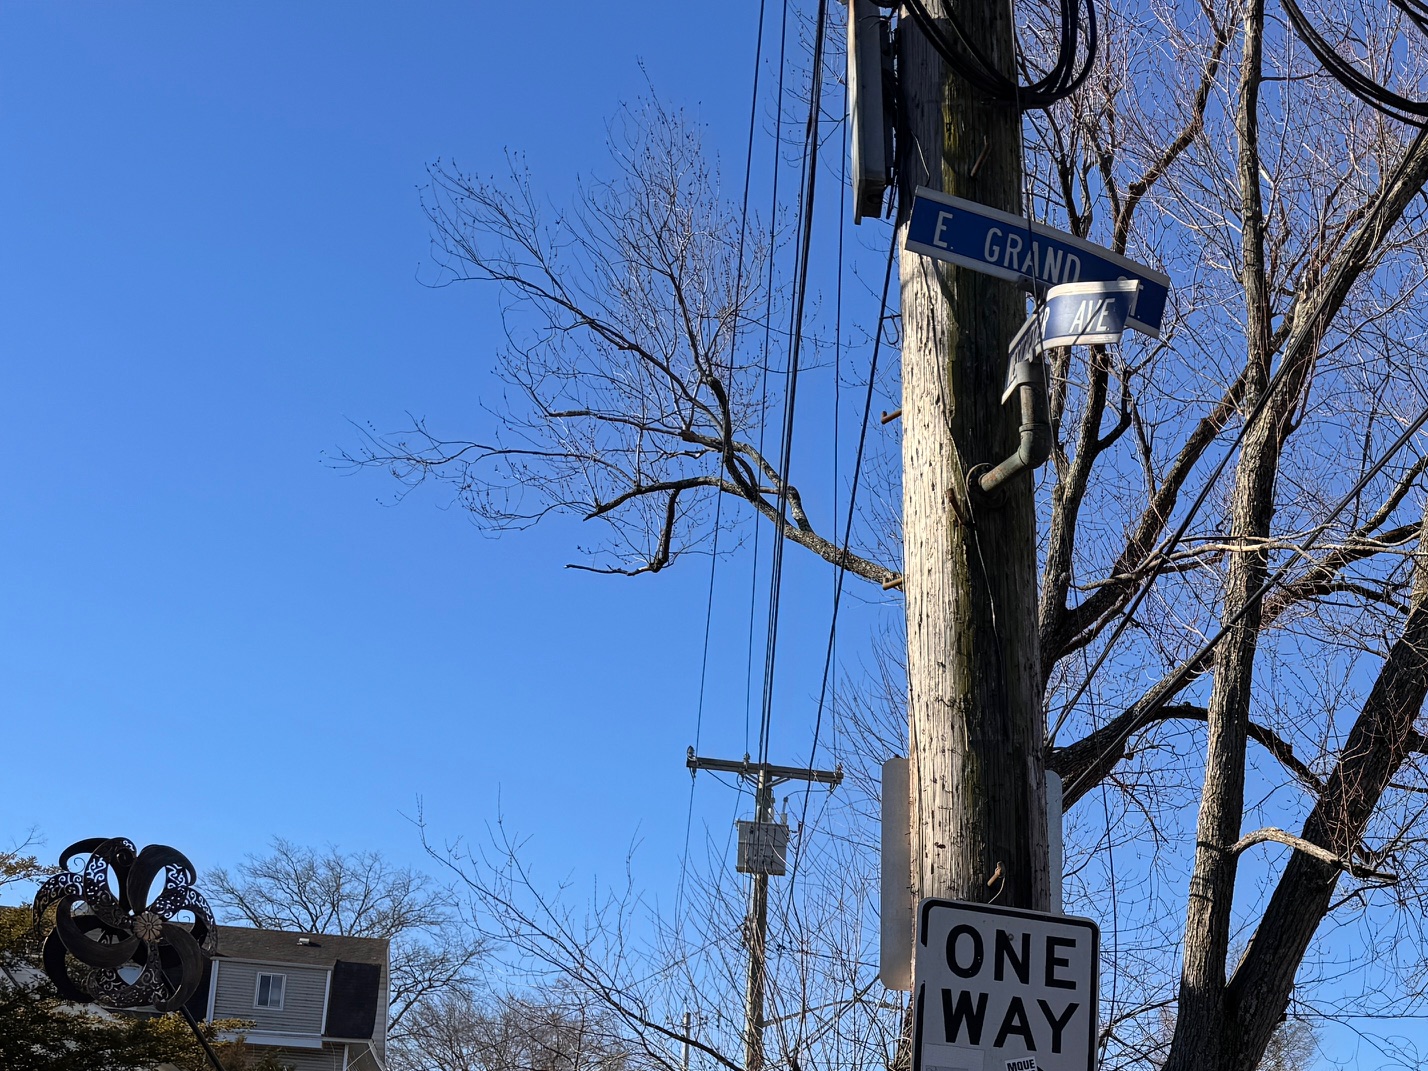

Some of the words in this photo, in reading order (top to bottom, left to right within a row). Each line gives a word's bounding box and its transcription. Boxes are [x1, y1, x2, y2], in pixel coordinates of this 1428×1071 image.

[984, 227, 1081, 284] GRAND
[1117, 276, 1144, 319] T.
[1069, 298, 1116, 334] AVE.
[945, 924, 1078, 990] ONE
[941, 988, 1080, 1054] WAY
